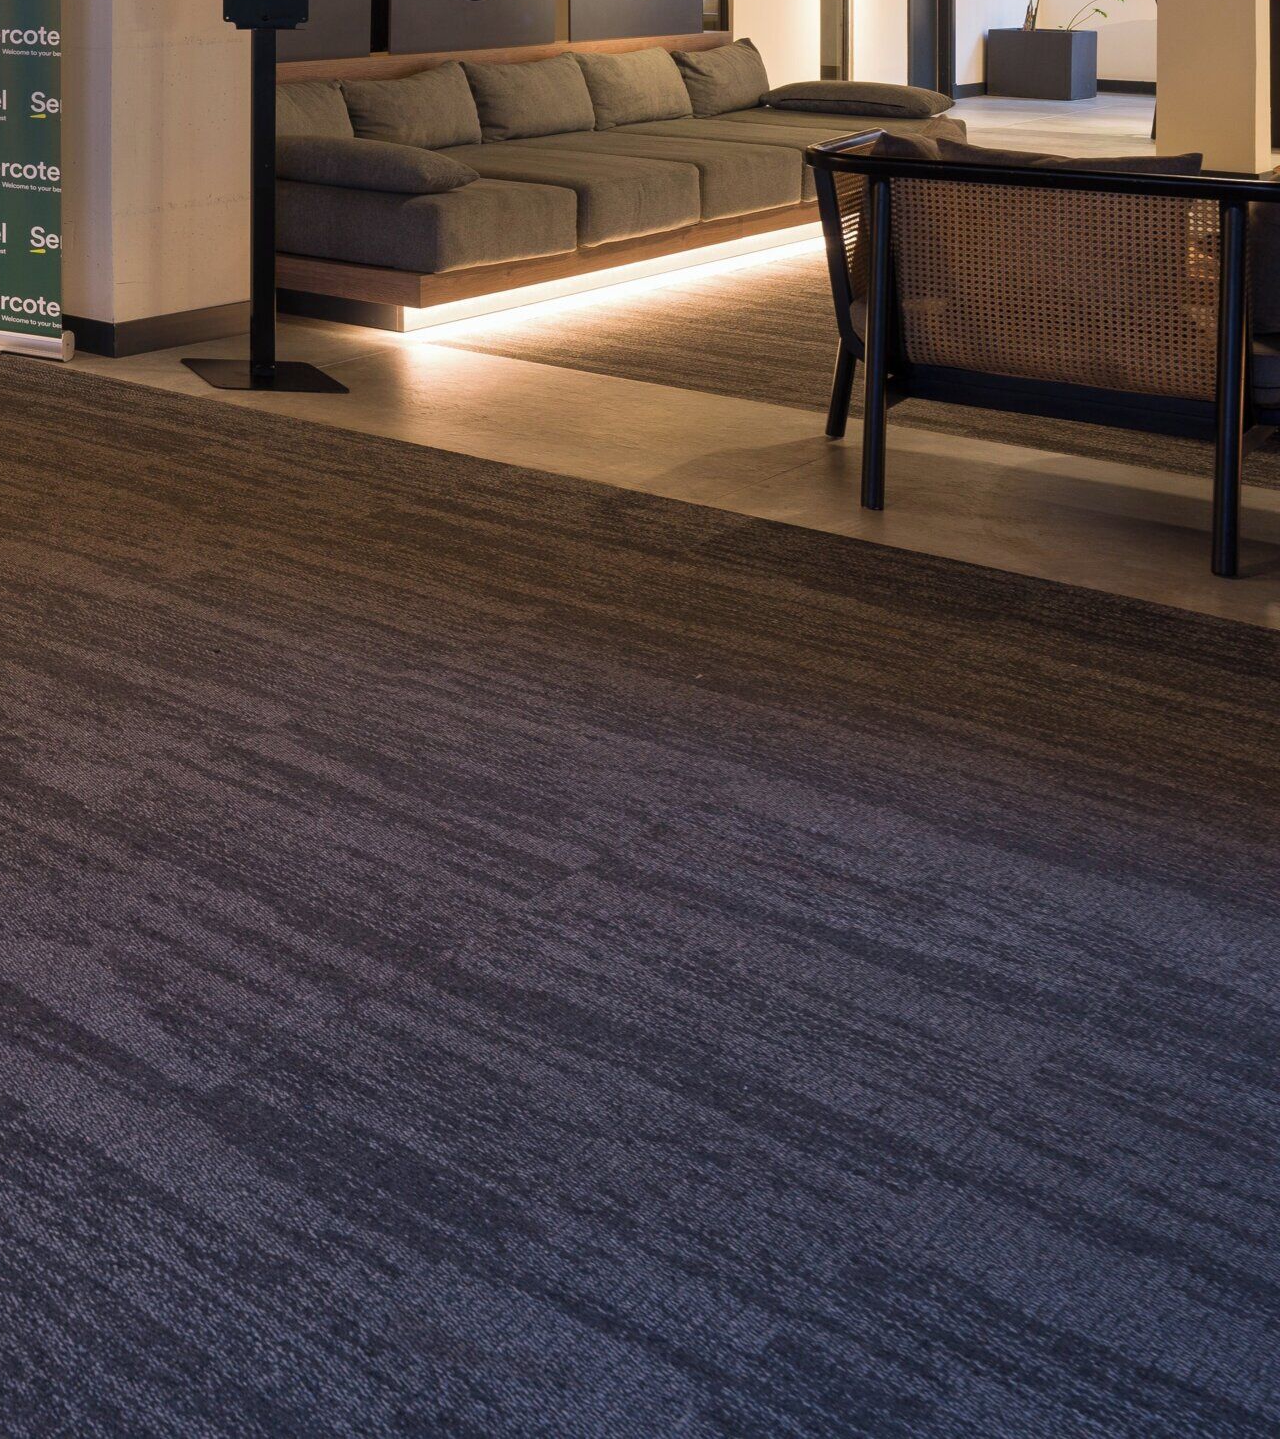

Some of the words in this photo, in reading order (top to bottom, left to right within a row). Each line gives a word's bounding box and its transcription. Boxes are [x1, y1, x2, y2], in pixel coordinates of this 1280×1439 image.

[30, 91, 62, 113] Se
[1, 181, 29, 190] Welcome
[30, 226, 62, 249] Se
[1, 315, 29, 324] Welcome
